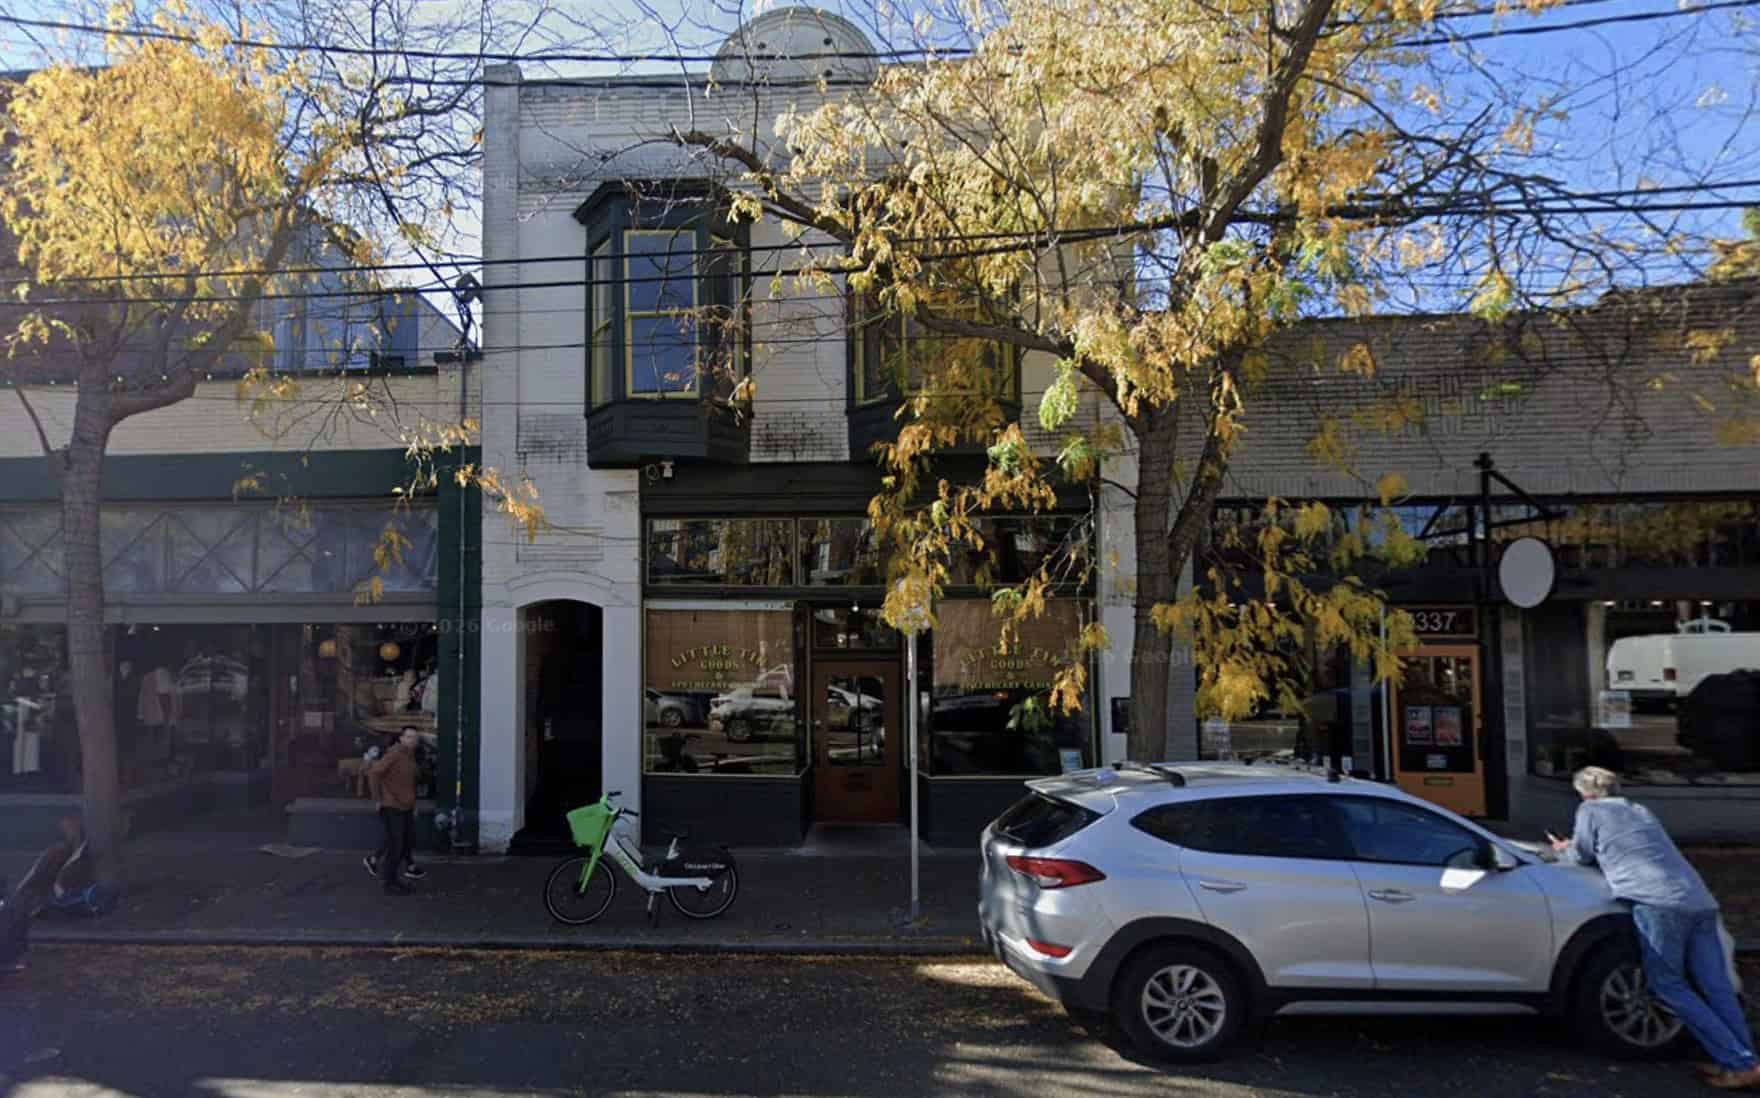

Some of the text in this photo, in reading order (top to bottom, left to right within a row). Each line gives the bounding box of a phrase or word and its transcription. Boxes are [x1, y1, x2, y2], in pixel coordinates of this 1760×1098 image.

[1405, 611, 1456, 631] 337
[671, 645, 768, 667] LITTLE TIN
[699, 659, 739, 669] GOODS
[960, 645, 1022, 667] LITTE
[1032, 647, 1061, 667] TIN
